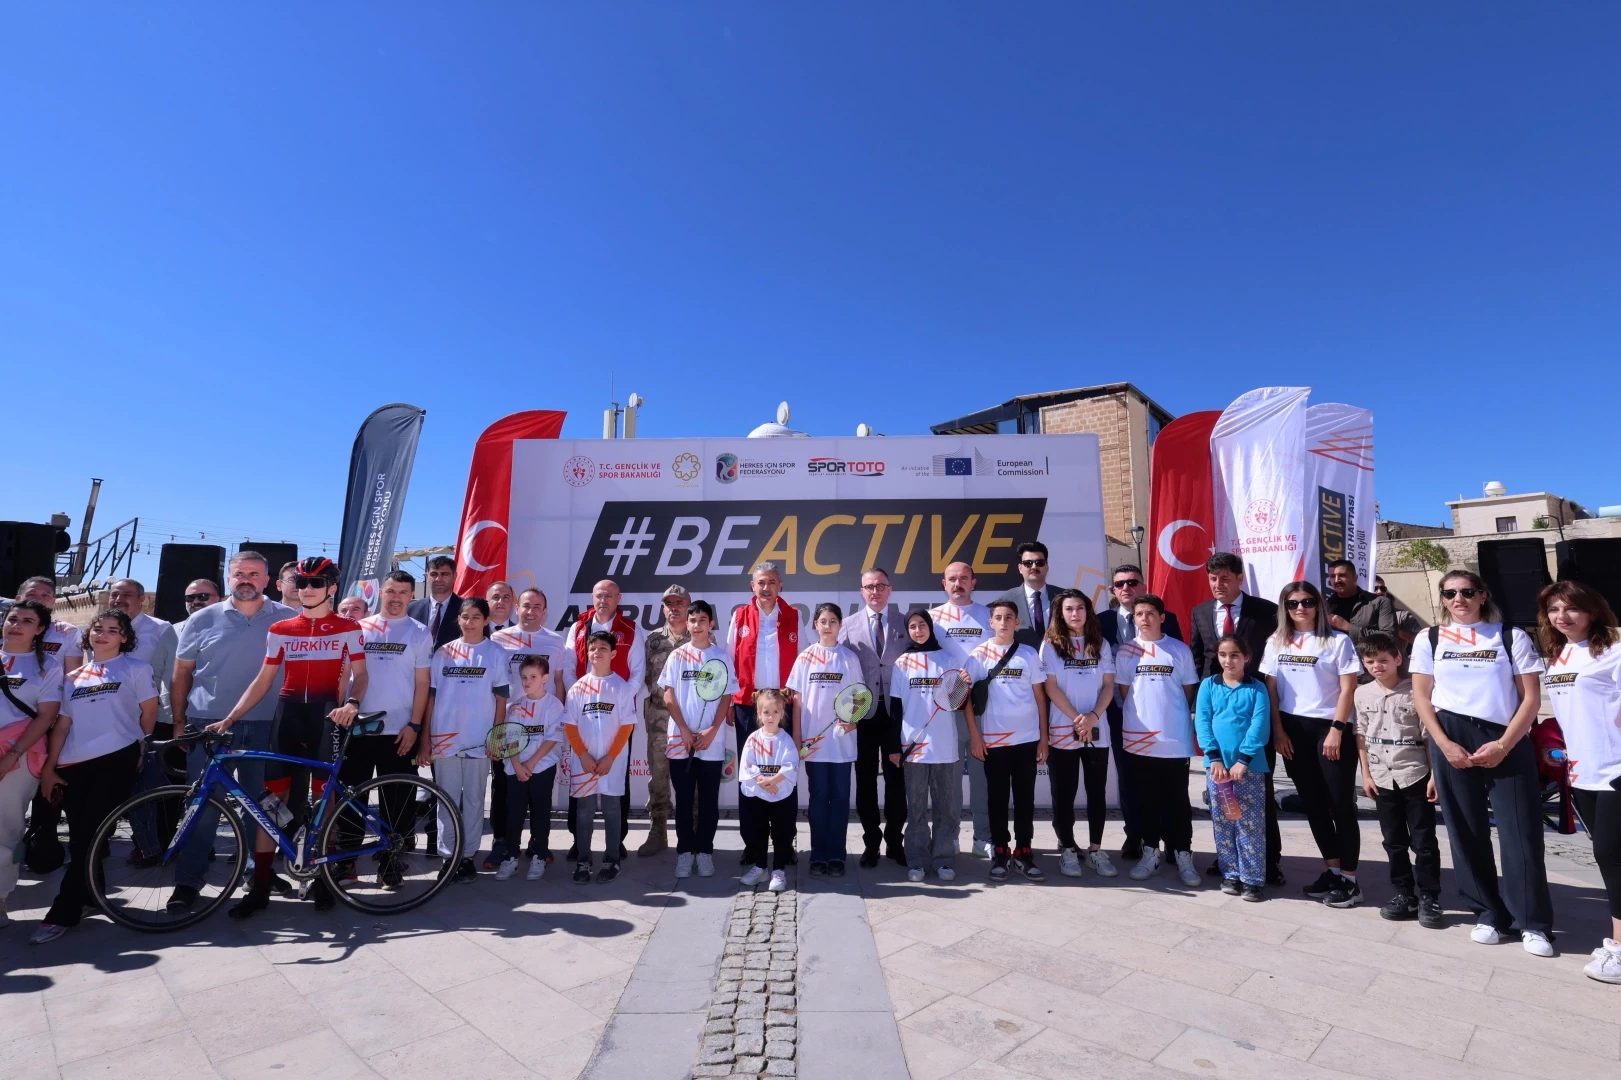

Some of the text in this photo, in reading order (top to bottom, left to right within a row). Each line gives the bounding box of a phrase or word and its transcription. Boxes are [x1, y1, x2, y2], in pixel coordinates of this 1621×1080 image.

[615, 462, 649, 472] GENÇLİK
[997, 460, 1033, 469] European
[599, 470, 661, 479] SPOR BAKANLIĞI
[997, 468, 1044, 476] Commission
[364, 532, 377, 576] HERKES
[374, 473, 386, 503] SPOR
[368, 491, 392, 575] FEDERASYONU
[603, 513, 1024, 577] #BEACTIVE
[1231, 534, 1297, 547] T.C. GENÇLİK VE
[1357, 530, 1368, 551] Eylül
[1231, 543, 1297, 555] SPOR BAKANLIĞI
[1358, 551, 1367, 562] 30
[1359, 568, 1367, 578] 23
[284, 638, 340, 652] TÜRKİYE
[365, 642, 404, 650] #BEACTIVE
[1278, 654, 1317, 664] #BEACTIVE
[1137, 665, 1172, 673] #BEACTIVE
[1544, 673, 1576, 684] BEACTIVE
[73, 682, 119, 696] #BEACTIVE
